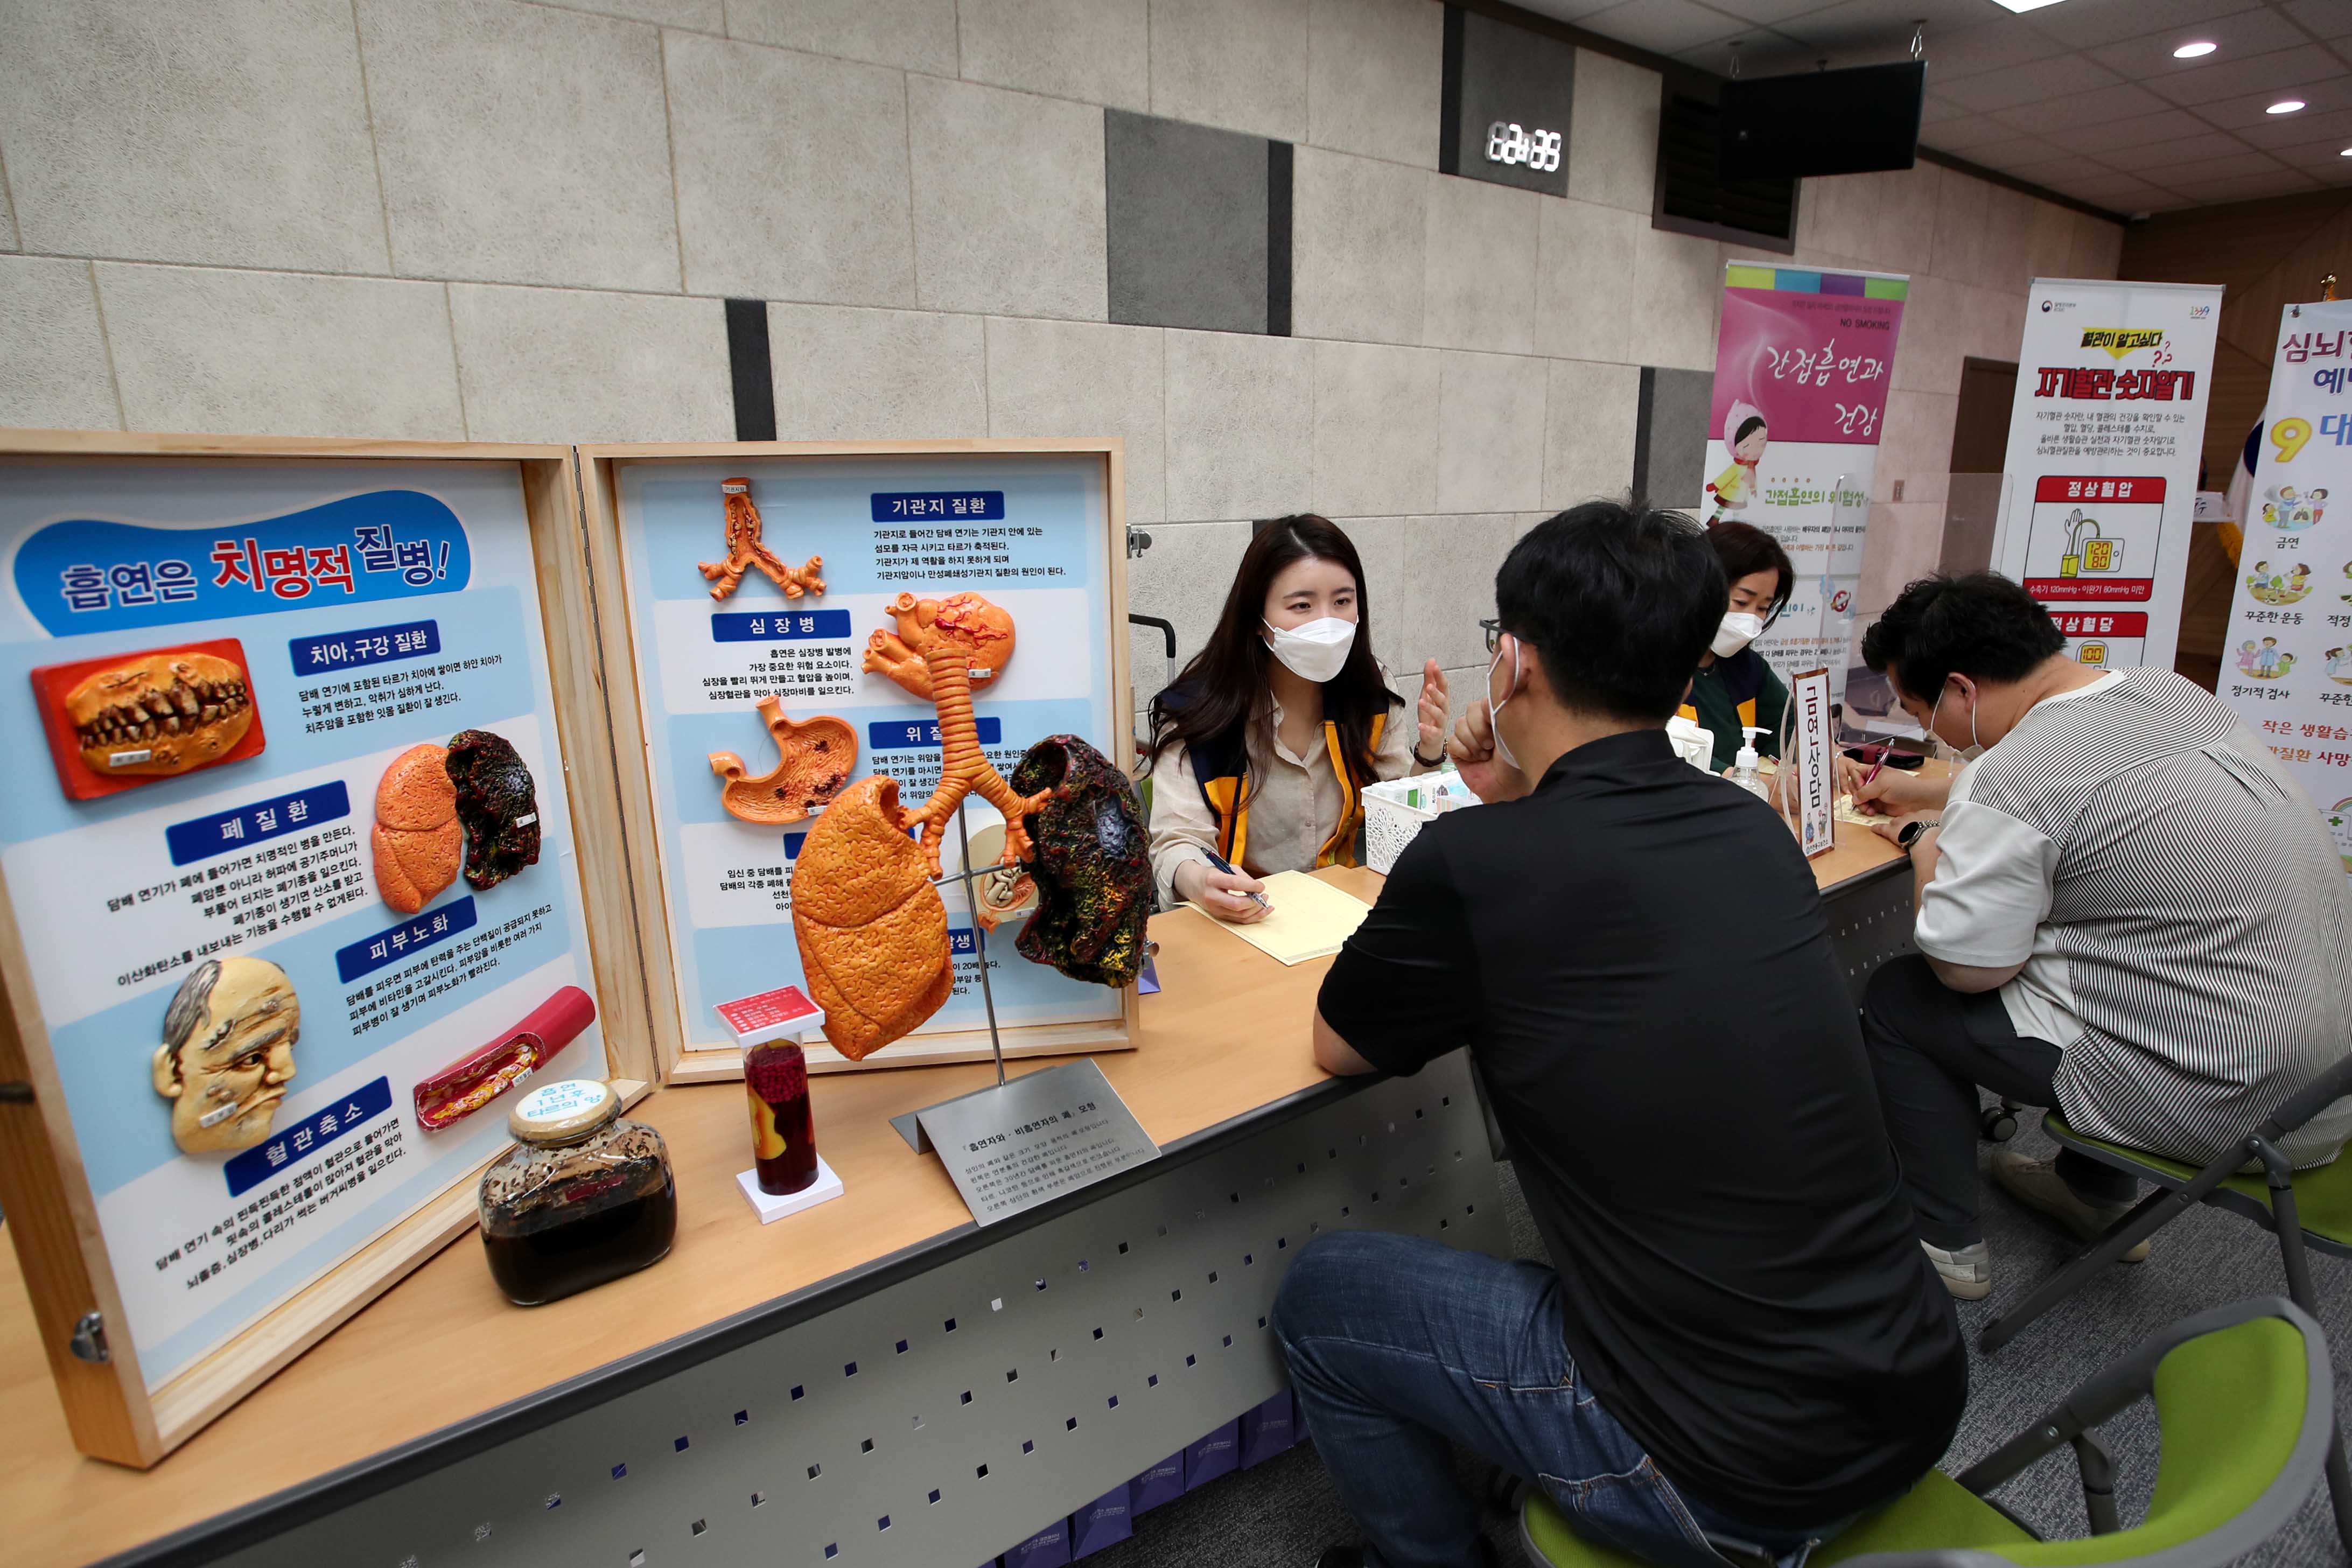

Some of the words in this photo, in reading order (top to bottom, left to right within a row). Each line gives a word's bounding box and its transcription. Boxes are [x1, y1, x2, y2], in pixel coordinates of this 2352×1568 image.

[1840, 319, 1852, 327] NO
[1856, 319, 1889, 330] SMOKING
[2081, 331, 2114, 347] 혈관이
[2117, 331, 2162, 348] 알고싶다
[2283, 330, 2352, 363] 심뇌
[1767, 339, 1884, 387] 간접흡연과
[2034, 367, 2116, 399] 자기혈관
[2116, 370, 2195, 400] 숫자알기
[1835, 403, 1878, 436] 건강
[2270, 417, 2313, 463] 9
[892, 498, 943, 515] 기관지
[951, 498, 985, 514] 질환
[1765, 488, 1824, 506] 간접흡연의
[874, 530, 907, 538] 기관지로
[908, 529, 933, 538] 들어간
[936, 528, 952, 537] 담배
[954, 528, 979, 537] 연기는
[982, 527, 1005, 536] 기관지
[1007, 527, 1024, 536] 안에
[1026, 527, 1042, 535] 있는
[2091, 543, 2109, 555] 120
[2276, 537, 2299, 549] 금연
[61, 559, 198, 613] 흡연은
[211, 538, 355, 599] 치명적
[355, 524, 451, 586] 질병!
[876, 557, 908, 566] 기관지가
[911, 557, 919, 565] 제
[948, 556, 964, 564] 하지
[967, 555, 991, 564] 못하게
[993, 555, 1009, 563] 되며
[2092, 556, 2107, 568] 80
[877, 570, 926, 580] 기관지암이나
[995, 568, 1018, 577] 질환의
[1021, 567, 1045, 576] 원인이
[1047, 566, 1066, 575] 된다.
[2030, 585, 2048, 593] 수축기
[2050, 586, 2076, 594] 120mmHg
[2082, 586, 2101, 594] 이완기
[2103, 586, 2129, 594] 80mmHg
[2245, 611, 2279, 624] 꾸준한
[2281, 612, 2304, 625] 운동
[394, 629, 426, 652] 질환
[770, 648, 795, 658] 흡연은
[798, 648, 823, 657] 심장병
[825, 647, 851, 656] 발병에
[2083, 648, 2102, 660] 100
[298, 688, 319, 702] 담배
[321, 682, 351, 697] 연기에
[353, 676, 380, 691] 포함된
[382, 671, 409, 685] 타르가
[411, 666, 436, 680] 치아에
[437, 661, 461, 675] 쌓이면
[463, 659, 478, 669] 하얀
[480, 654, 501, 666] 치아가
[702, 676, 727, 687] 심장을
[730, 676, 747, 685] 빨리
[750, 675, 767, 684] 뛰게
[769, 675, 795, 683] 만들고
[797, 673, 822, 682] 혈압을
[302, 702, 332, 718] 누렇게
[334, 697, 366, 711] 변하고,
[368, 689, 395, 703] 악취가
[397, 684, 423, 698] 심하게
[424, 680, 444, 692] 난다.
[2231, 685, 2264, 699] 정기적
[2267, 687, 2290, 700] 검사
[305, 716, 344, 733] 치주암을
[347, 710, 374, 725] 포함한
[376, 705, 394, 719] 잇몸
[396, 699, 422, 714] 질환이
[424, 697, 432, 708] 잘
[434, 692, 461, 706] 생긴다.
[2263, 720, 2293, 736] 작은
[2300, 722, 2352, 741] 생활습
[1805, 685, 1822, 809] 금연상담
[872, 756, 887, 765] 담배
[891, 754, 914, 763] 연기는
[918, 753, 941, 762] 위암을
[107, 894, 134, 912] 담배
[138, 881, 176, 901] 연기가
[179, 872, 204, 887] 폐에
[207, 856, 252, 880] 들어가면
[255, 842, 297, 863] 치명적인
[299, 835, 320, 850] 병을
[322, 825, 355, 843] 만든다.
[727, 870, 744, 878] 임신
[758, 867, 782, 876] 담배를
[720, 882, 745, 891] 담배의
[748, 880, 764, 888] 각종
[117, 950, 192, 985] 이산화탄소를
[197, 934, 242, 956] 내보내는
[246, 918, 277, 937] 기능을
[281, 906, 311, 925] 수행할
[314, 902, 324, 913] 수
[326, 886, 367, 909] 없게된다.
[346, 985, 373, 1006] 담배를
[375, 972, 402, 991] 피우면
[403, 960, 429, 978] 피부에
[430, 948, 453, 967] 탄력을
[456, 942, 471, 954] 주는
[472, 926, 501, 947] 단백질이
[503, 913, 530, 932] 공급되지
[531, 904, 551, 919] 못하고
[1015, 1116, 1058, 1136] 비흡연자의
[1079, 1102, 1095, 1114] 모형
[292, 1163, 323, 1188] 점액이
[324, 1140, 362, 1169] 혈관으로
[364, 1117, 399, 1145] 들어가면
[355, 1144, 382, 1166] 혈관을
[384, 1132, 402, 1147] 막아
[368, 1148, 405, 1175] 일으킨다.
